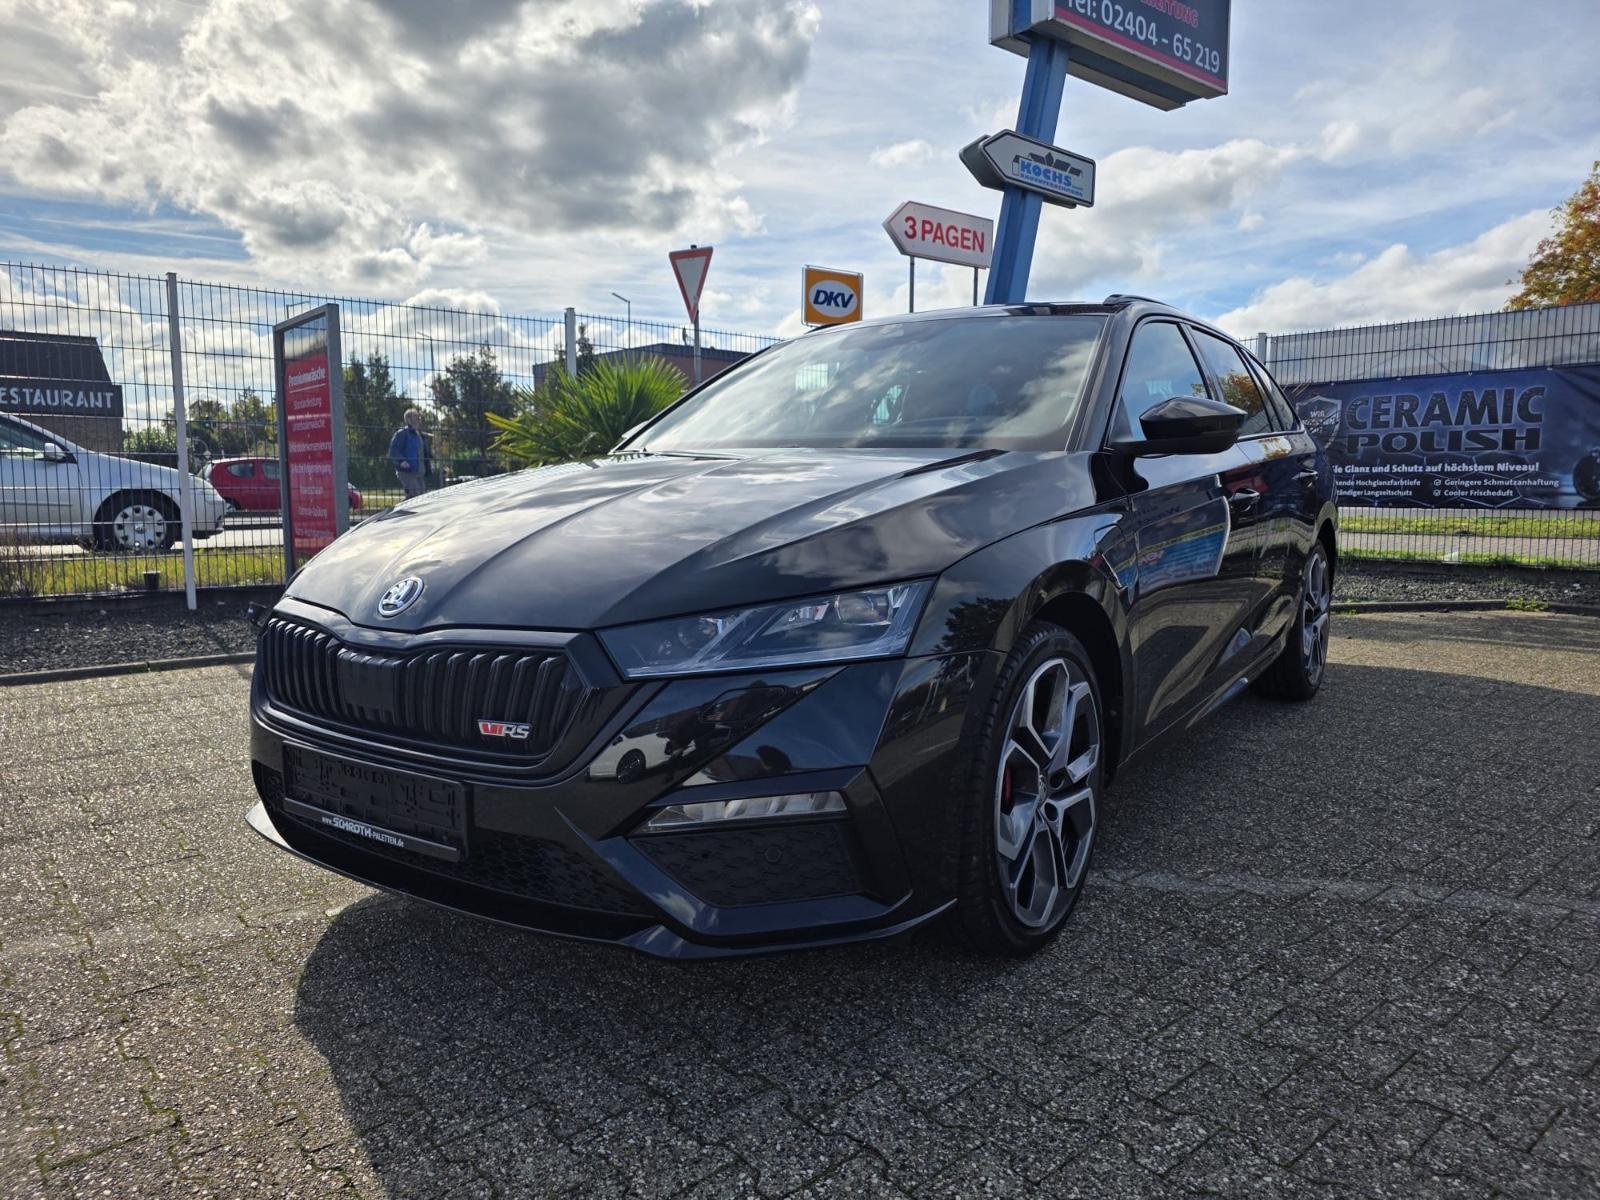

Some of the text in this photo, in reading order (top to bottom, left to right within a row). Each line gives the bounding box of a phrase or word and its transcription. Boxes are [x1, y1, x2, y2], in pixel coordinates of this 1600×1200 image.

[1101, 0, 1158, 46] 02404
[1173, 33, 1192, 61] 65
[1195, 43, 1220, 73] 219
[1020, 160, 1072, 187] KOCHS
[904, 215, 985, 253] 3 PAGEN
[813, 289, 854, 309] DKV
[1347, 386, 1546, 430] CERAMIC
[1347, 428, 1542, 454] POLISH
[1344, 464, 1370, 473] Glanz
[1372, 464, 1390, 473] und
[1392, 463, 1423, 473] Schutz
[1425, 463, 1443, 472] auf
[1444, 462, 1495, 472] höchstem
[1497, 461, 1540, 472] Niveau!
[1356, 478, 1421, 488] Hochglanzfarbtiefe
[1443, 489, 1514, 497] Cooler Frischeduft
[1444, 478, 1560, 488] Geringere Schmutzanhaftung
[1364, 489, 1413, 498] Langzeitschutz
